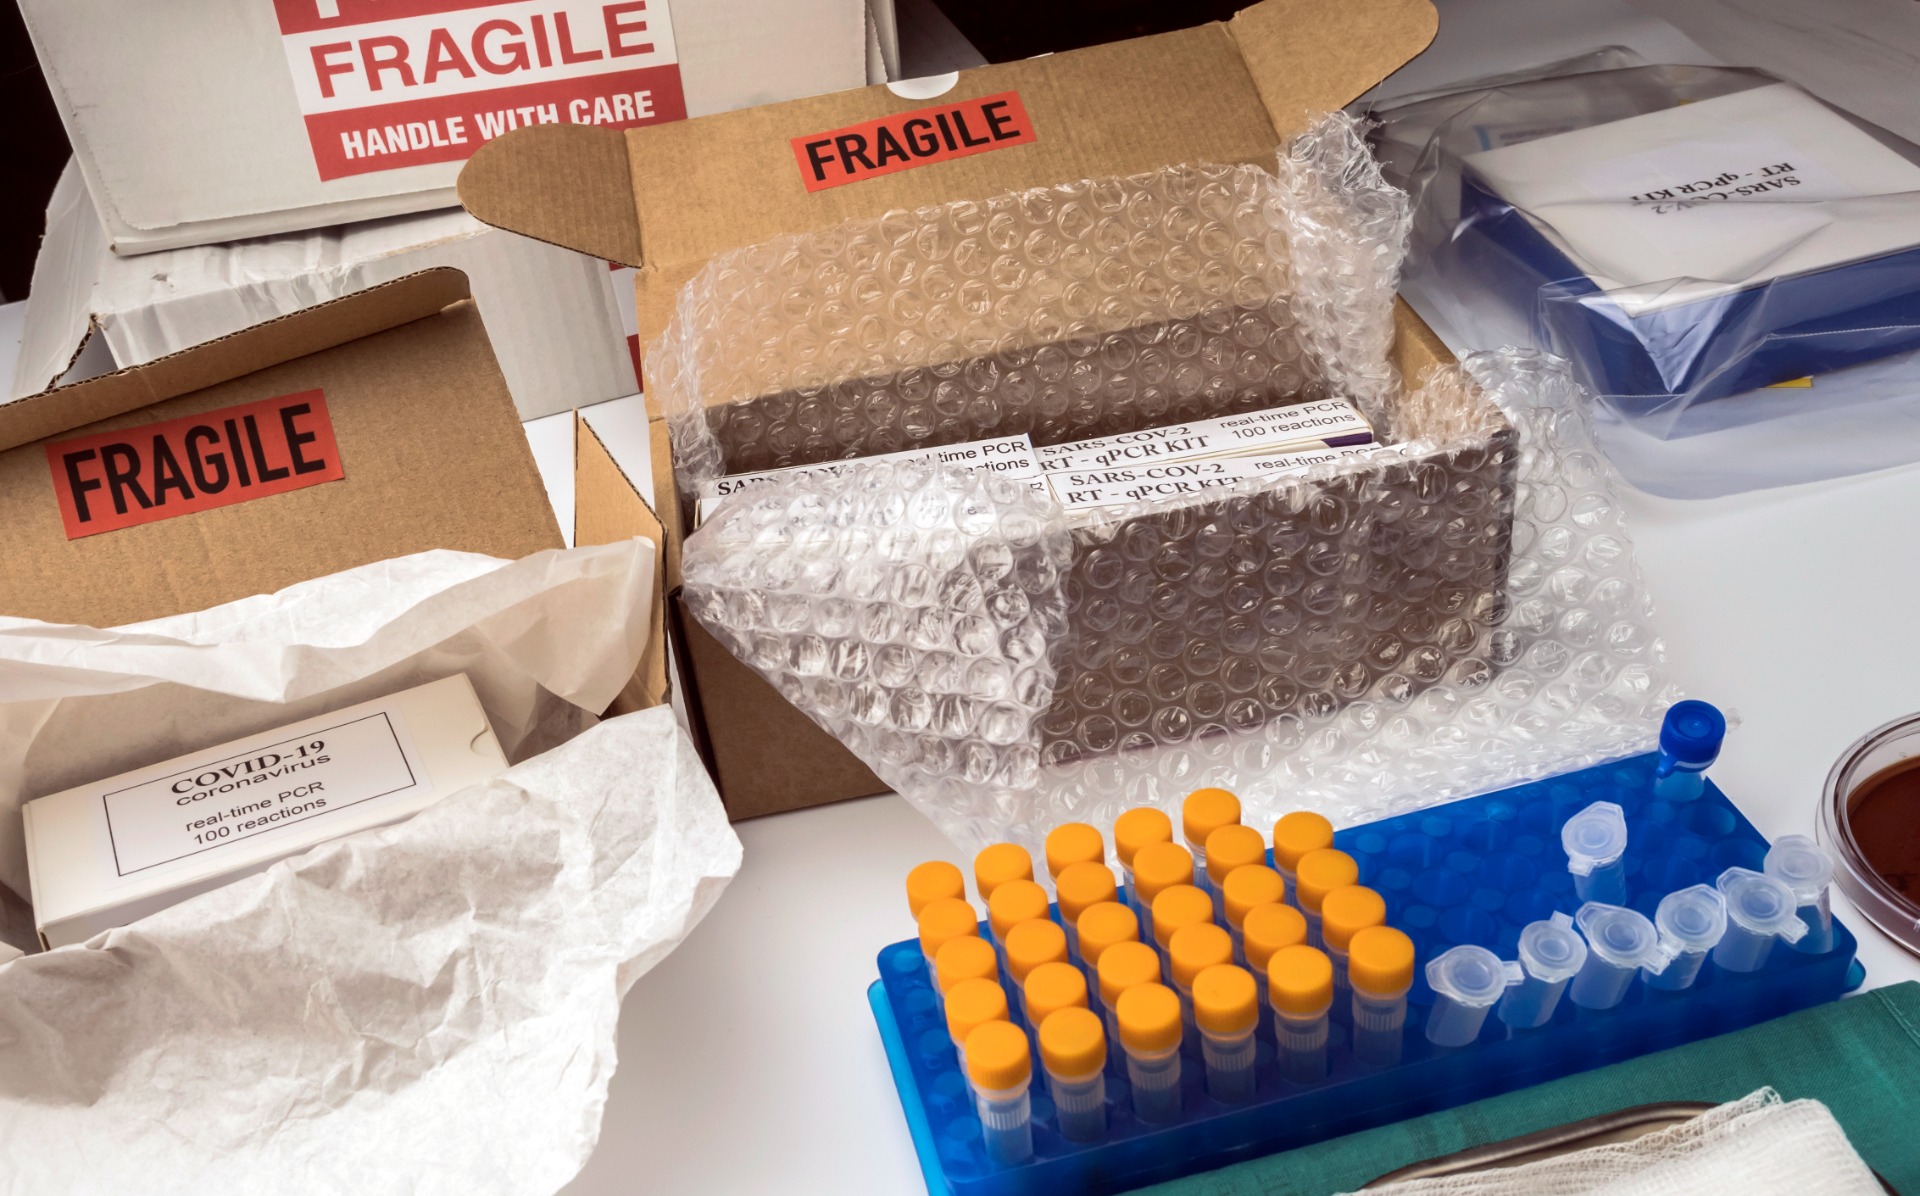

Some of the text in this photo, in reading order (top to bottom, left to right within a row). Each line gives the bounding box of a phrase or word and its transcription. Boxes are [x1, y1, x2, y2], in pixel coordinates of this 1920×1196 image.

[309, 0, 655, 99] FRAGILE
[340, 90, 655, 160] HANDLE WITH CARE
[805, 100, 1021, 182] FRAGILE
[1675, 172, 1740, 194] qPCR
[1760, 162, 1797, 178] RT
[1219, 400, 1350, 429] real-time PCR
[1232, 413, 1357, 439] 100 reactions
[982, 441, 1028, 457] PCR
[1039, 455, 1074, 471] RT
[1095, 443, 1162, 467] qPCR
[1164, 435, 1210, 453] KIT
[1042, 426, 1192, 457] SARS-COV-2
[62, 402, 326, 523] FRAGILE
[1069, 453, 1336, 486] SARS-COV-2 real-time
[1066, 488, 1103, 504] RT
[1125, 481, 1196, 501] qPCR
[171, 740, 325, 794] COVID-19
[176, 755, 332, 806] coronavirus
[186, 781, 326, 832] real-time PCR
[194, 798, 327, 845] 100 reactions
